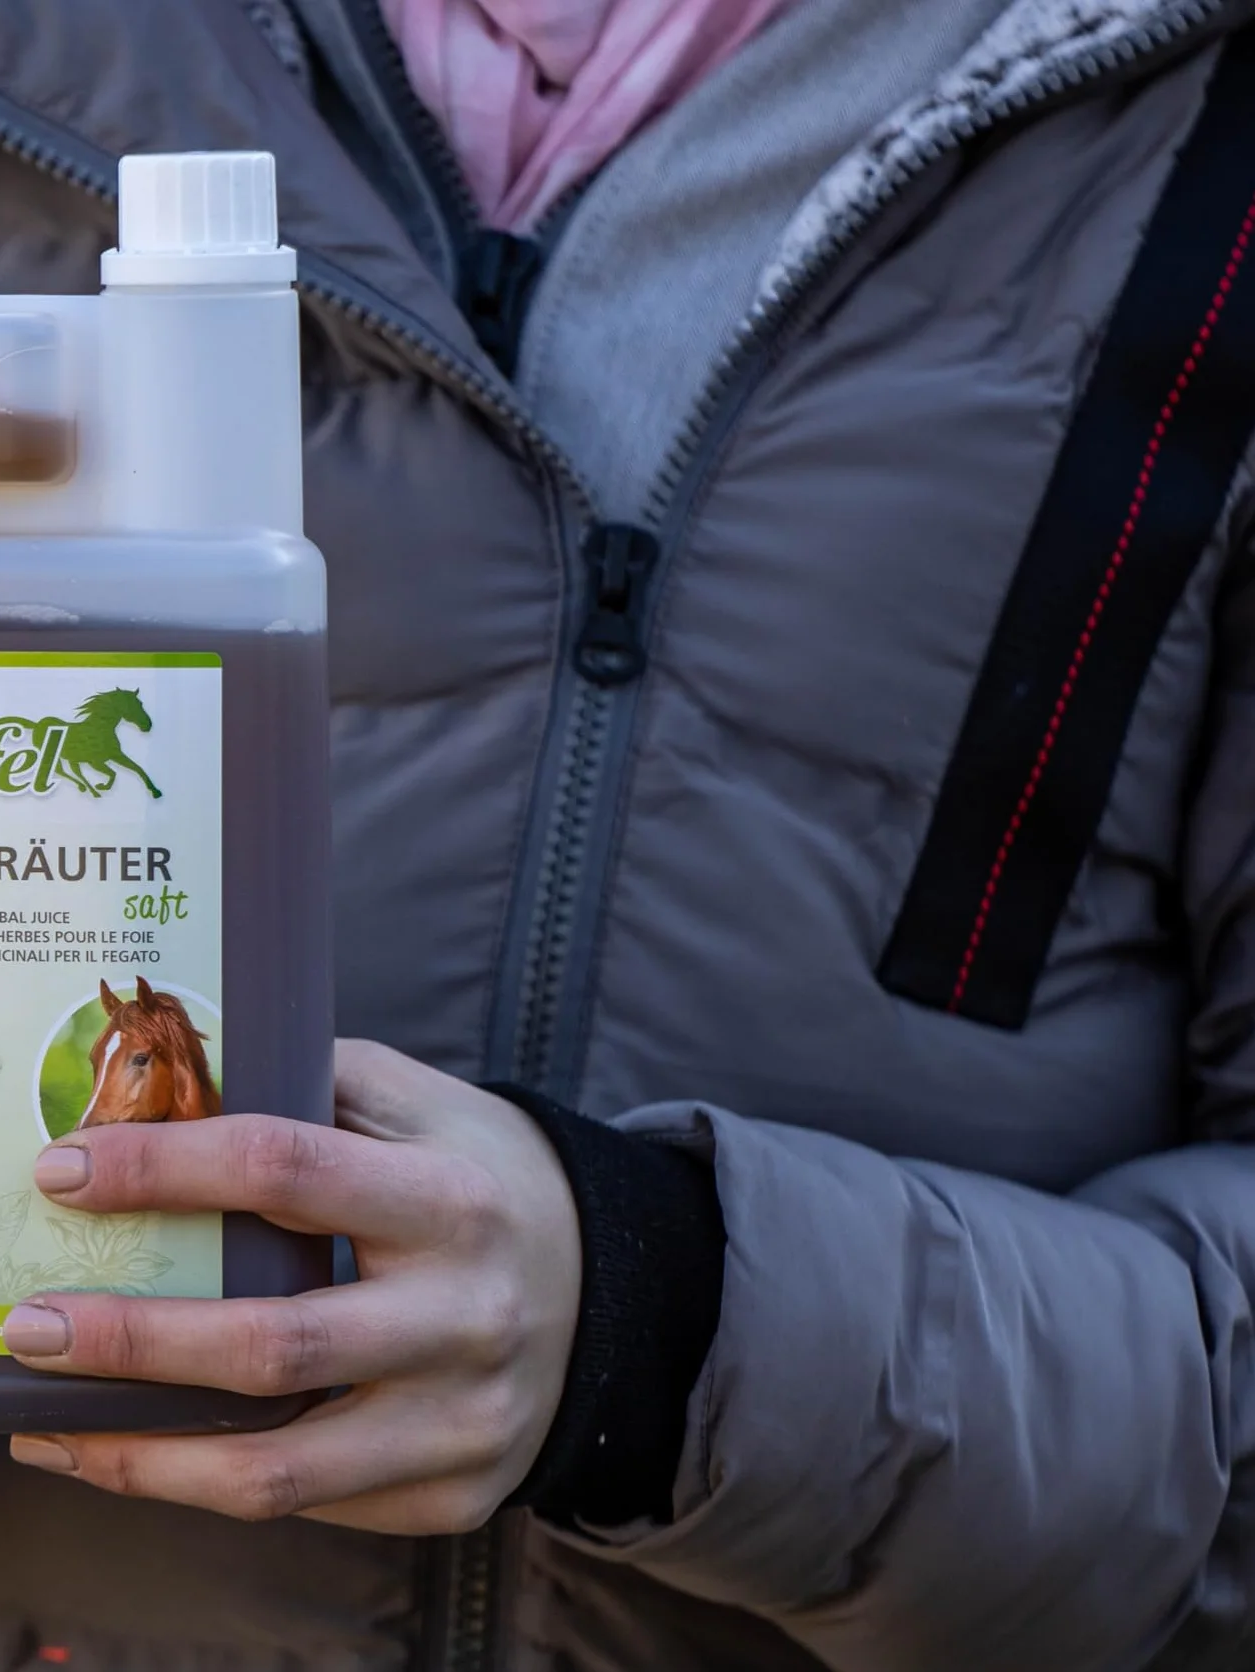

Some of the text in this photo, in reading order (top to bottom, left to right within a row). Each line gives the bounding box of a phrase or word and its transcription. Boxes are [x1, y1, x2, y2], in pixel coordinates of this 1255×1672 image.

[123, 885, 189, 925] saft
[30, 911, 72, 926] JUICE
[54, 931, 98, 945] POUR
[101, 931, 119, 945] LE
[121, 931, 156, 945] FOIE
[54, 950, 82, 964] PER
[85, 950, 99, 964] IL
[101, 950, 162, 965] FEGATO
